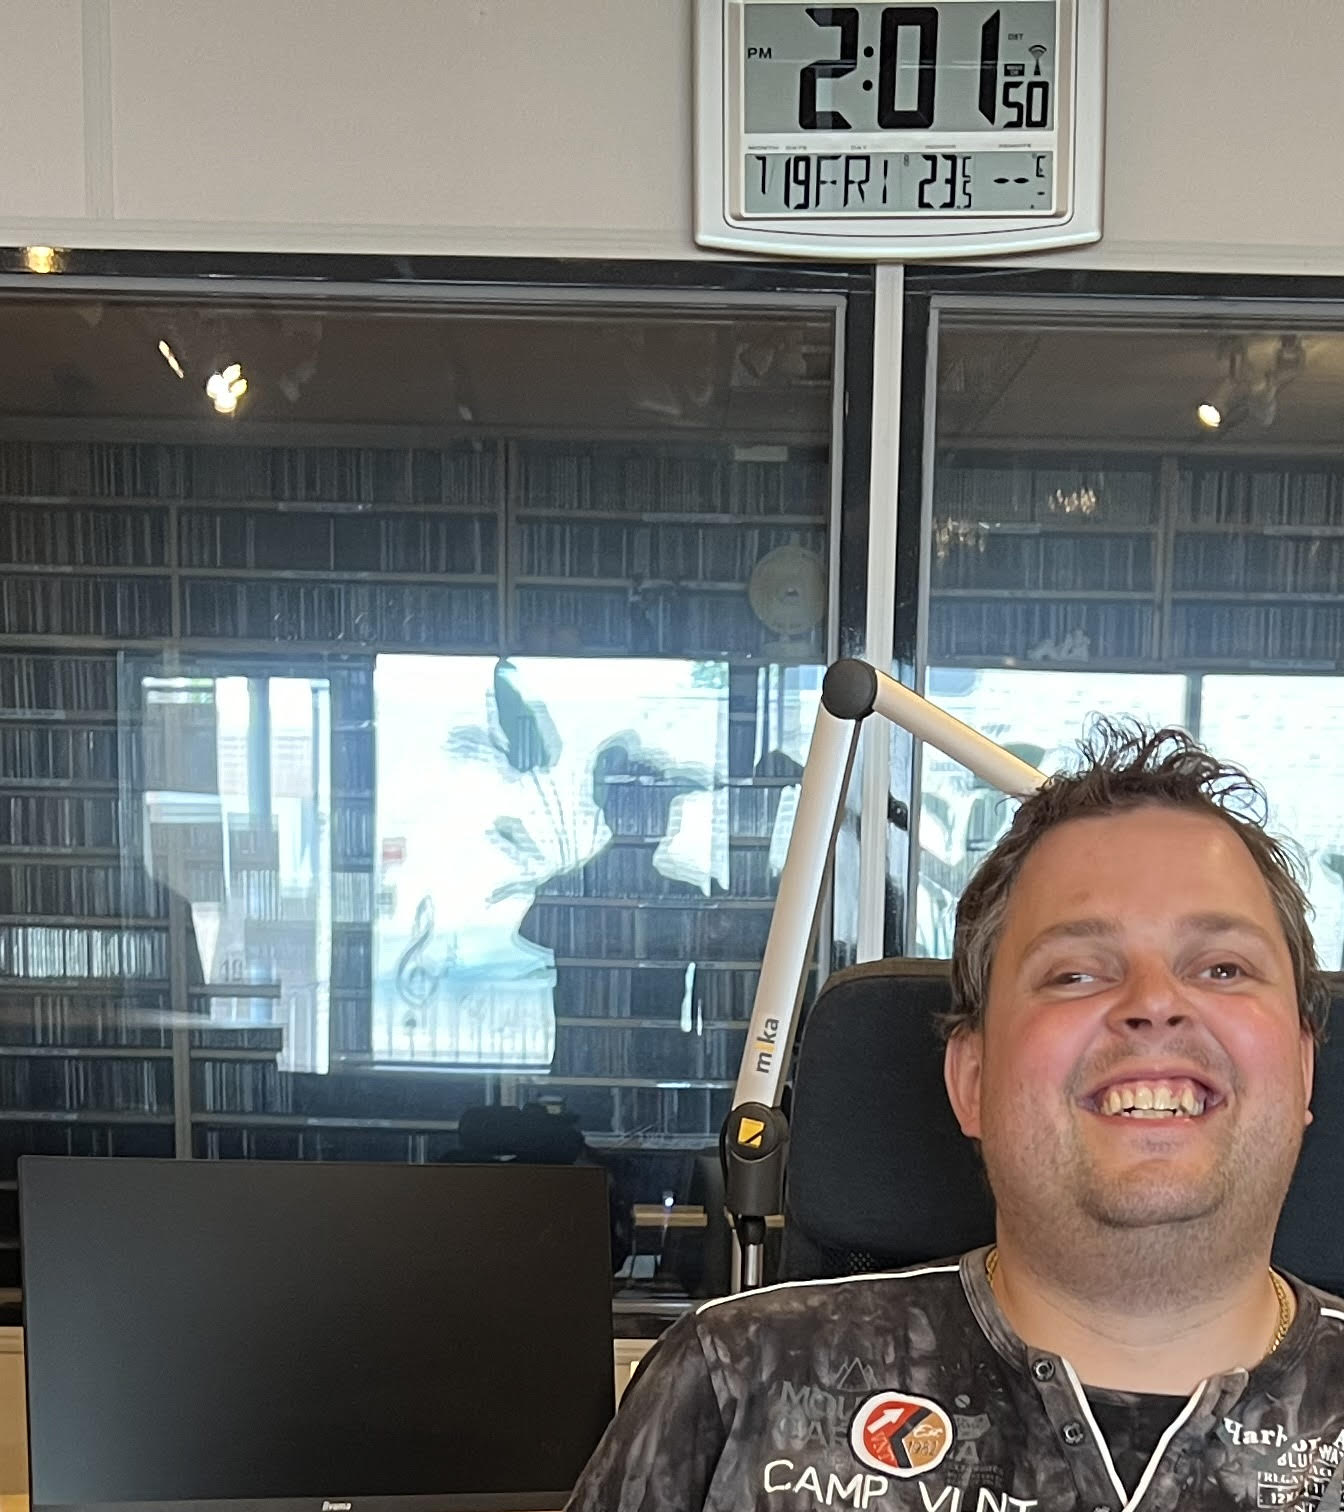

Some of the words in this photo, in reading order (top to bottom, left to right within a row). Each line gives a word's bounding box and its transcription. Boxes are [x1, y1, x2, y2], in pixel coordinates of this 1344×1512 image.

[746, 47, 772, 59] PM
[799, 6, 1001, 130] 2:01
[1002, 80, 1050, 128] 50
[763, 1458, 889, 1510] CAMP
